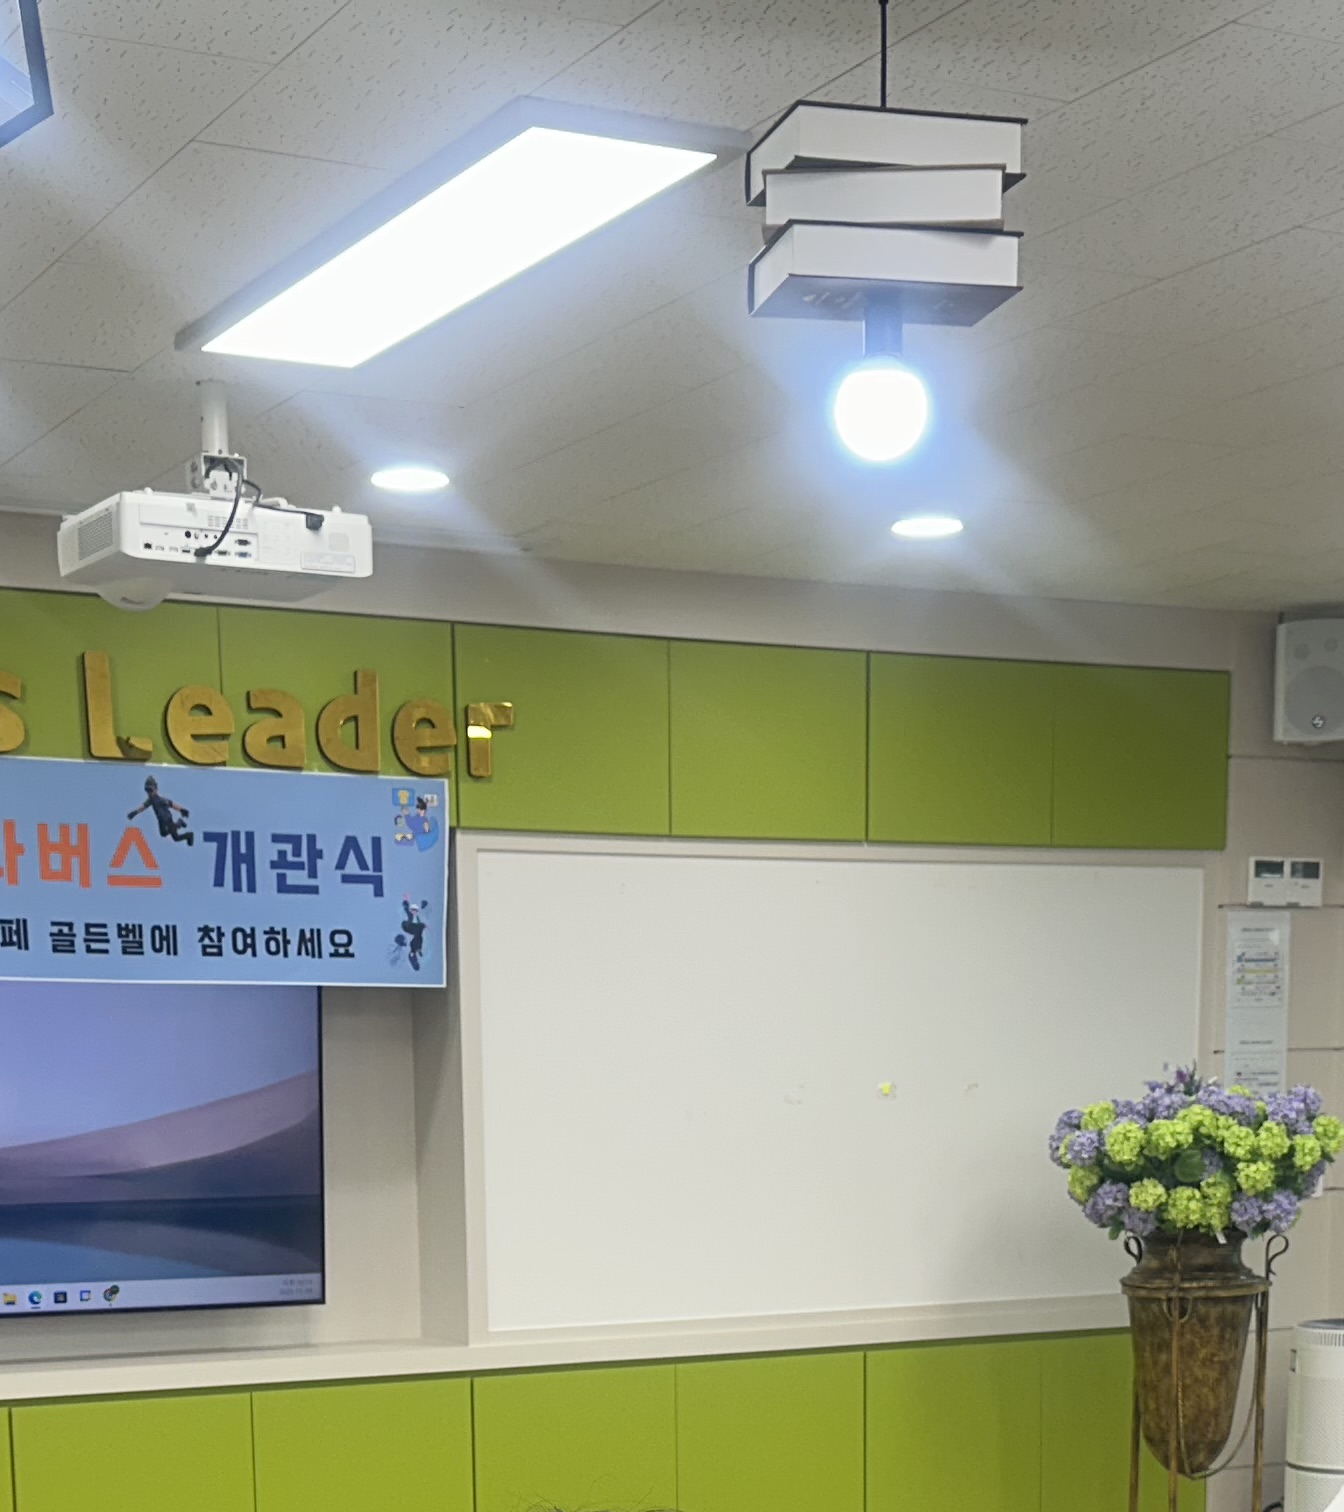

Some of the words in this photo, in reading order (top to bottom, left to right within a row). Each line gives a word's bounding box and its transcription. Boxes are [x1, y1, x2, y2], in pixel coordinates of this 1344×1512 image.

[82, 649, 514, 778] Leader
[202, 830, 385, 898] 개관식
[49, 920, 179, 957] 골든벨에
[197, 924, 356, 960] 참여하세요
